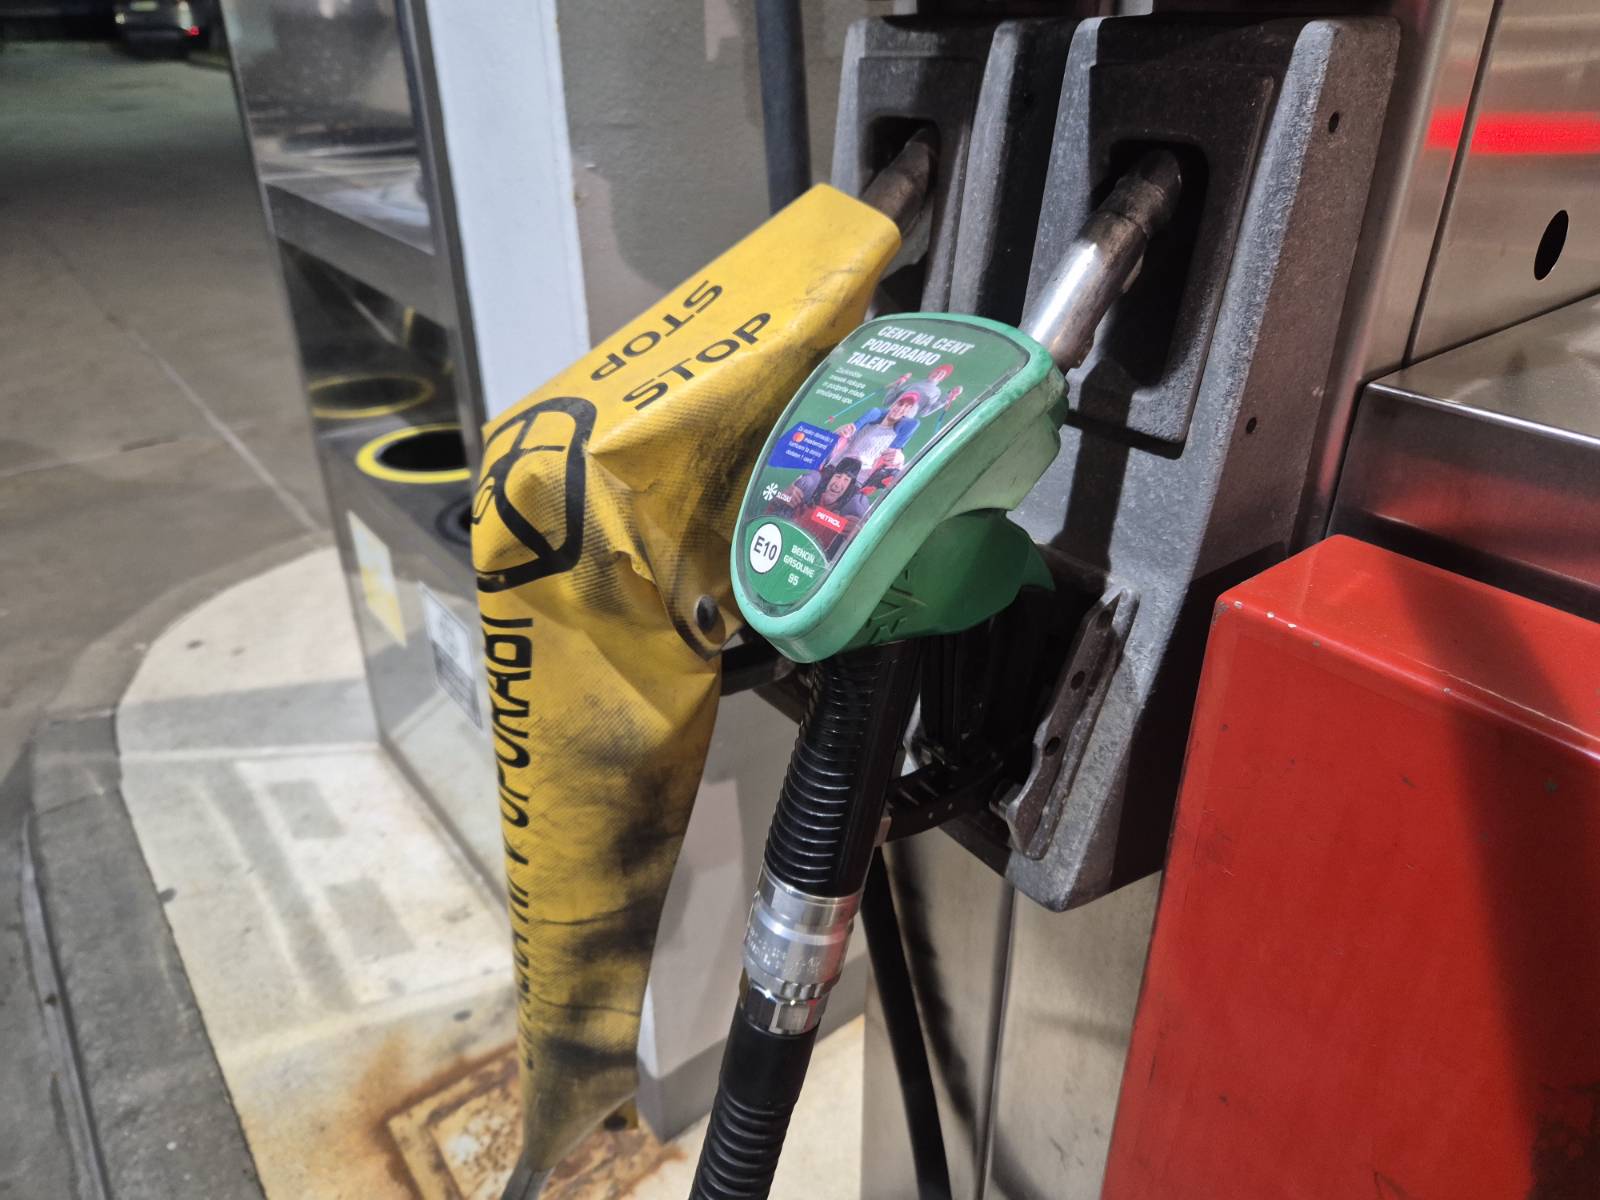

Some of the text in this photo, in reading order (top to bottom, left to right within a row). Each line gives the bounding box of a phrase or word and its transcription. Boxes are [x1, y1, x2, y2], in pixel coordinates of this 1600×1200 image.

[590, 280, 723, 381] STOP
[877, 325, 975, 355] CENT NA CENT
[622, 312, 771, 411] STOP
[847, 351, 896, 373] TALENT
[861, 338, 941, 366] PODPIRAMO
[816, 511, 841, 528] PETROL
[753, 535, 778, 561] E10
[791, 545, 816, 564] BENCIN
[783, 555, 816, 578] GASOLINE
[787, 572, 800, 586] 95
